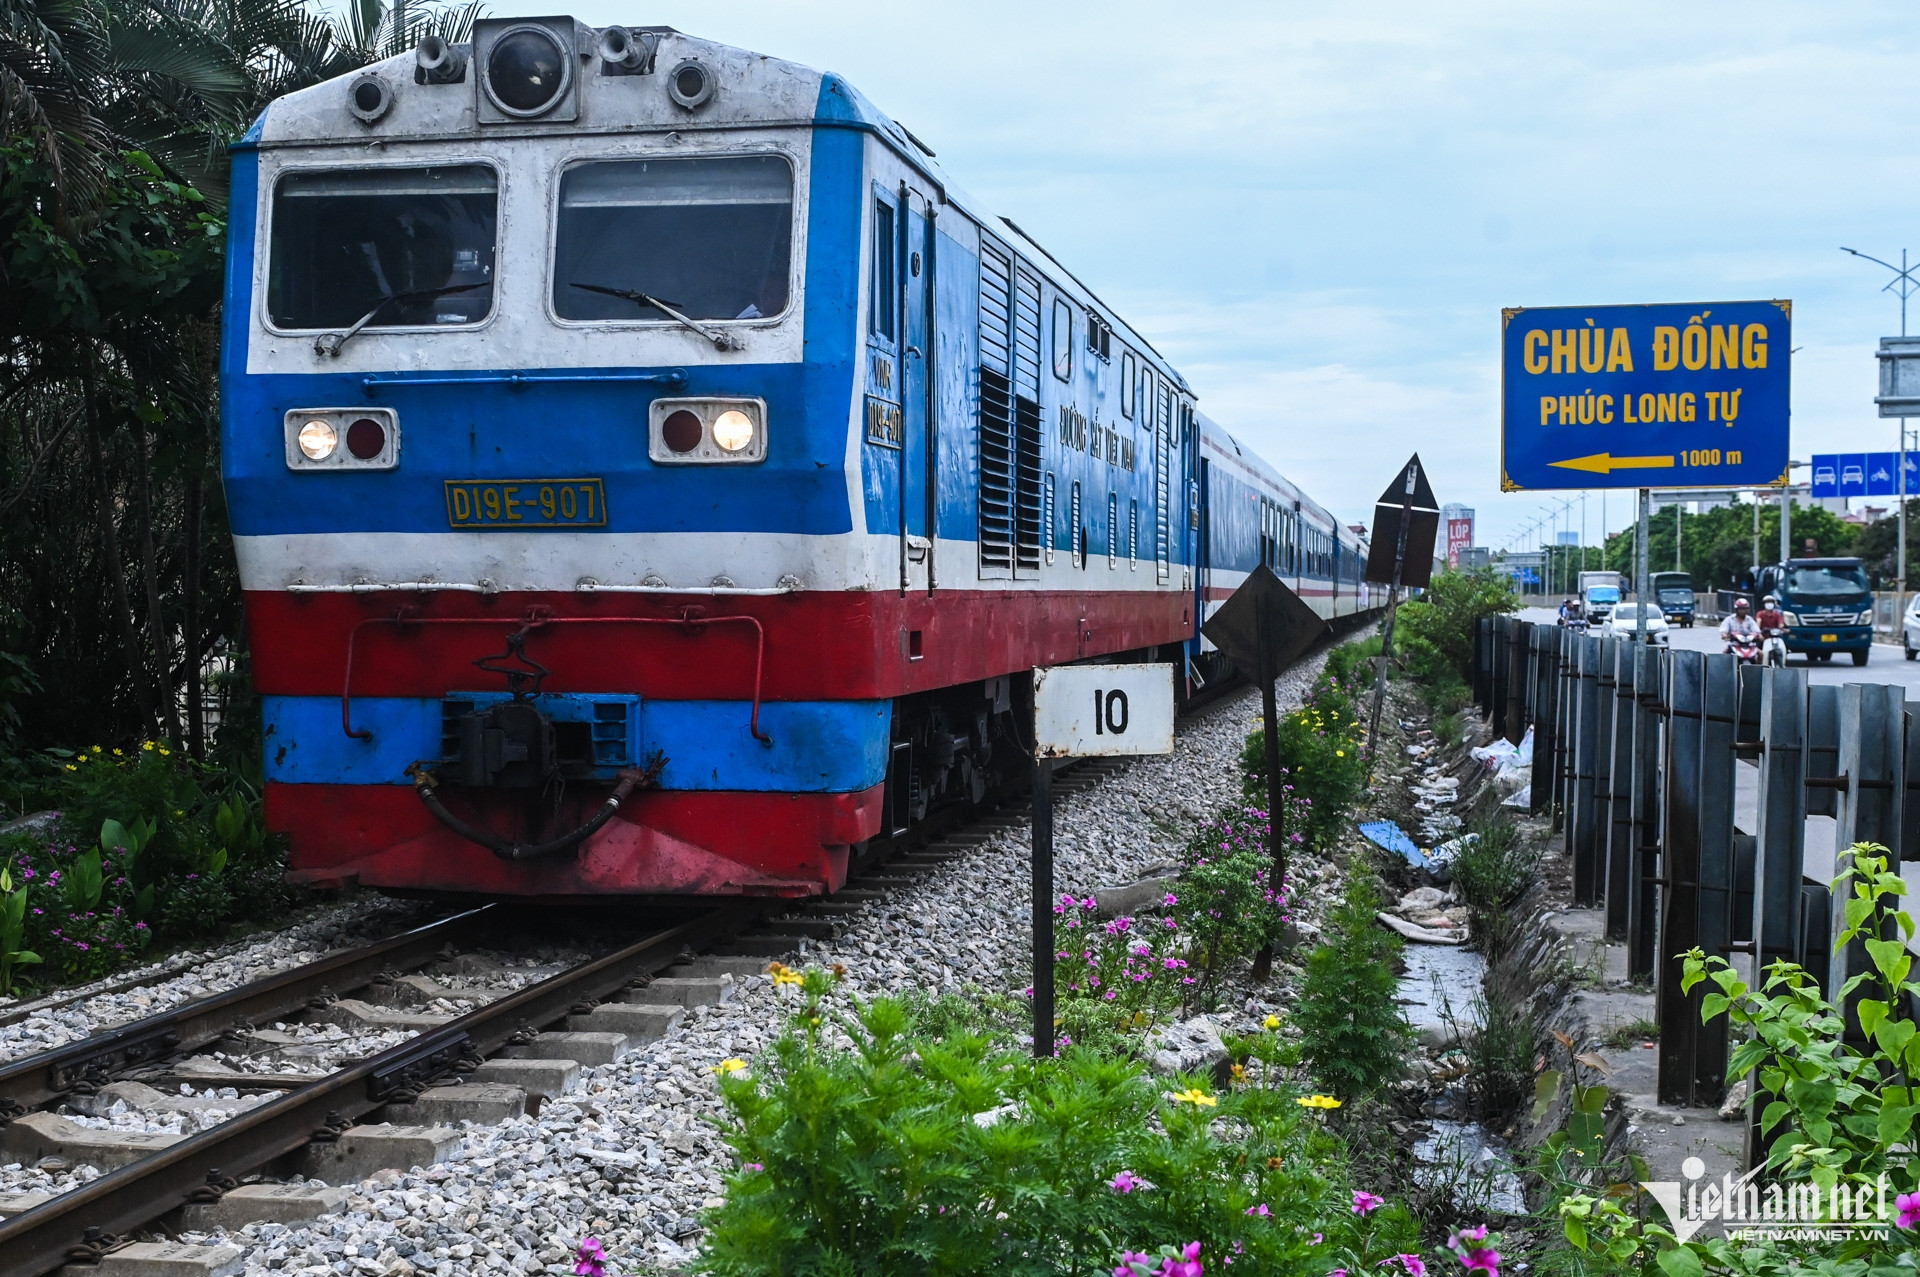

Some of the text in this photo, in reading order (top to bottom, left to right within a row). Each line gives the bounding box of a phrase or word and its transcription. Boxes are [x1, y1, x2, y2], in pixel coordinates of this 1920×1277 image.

[1524, 310, 1768, 375] CHÙA ĐỐNG
[873, 355, 891, 391] VNR
[1540, 388, 1742, 427] PHÚC LONG TỰ
[1121, 435, 1135, 473] NAM
[1680, 449, 1742, 467] 1000 m
[453, 486, 595, 520] D19E-907
[1095, 689, 1128, 735] 10
